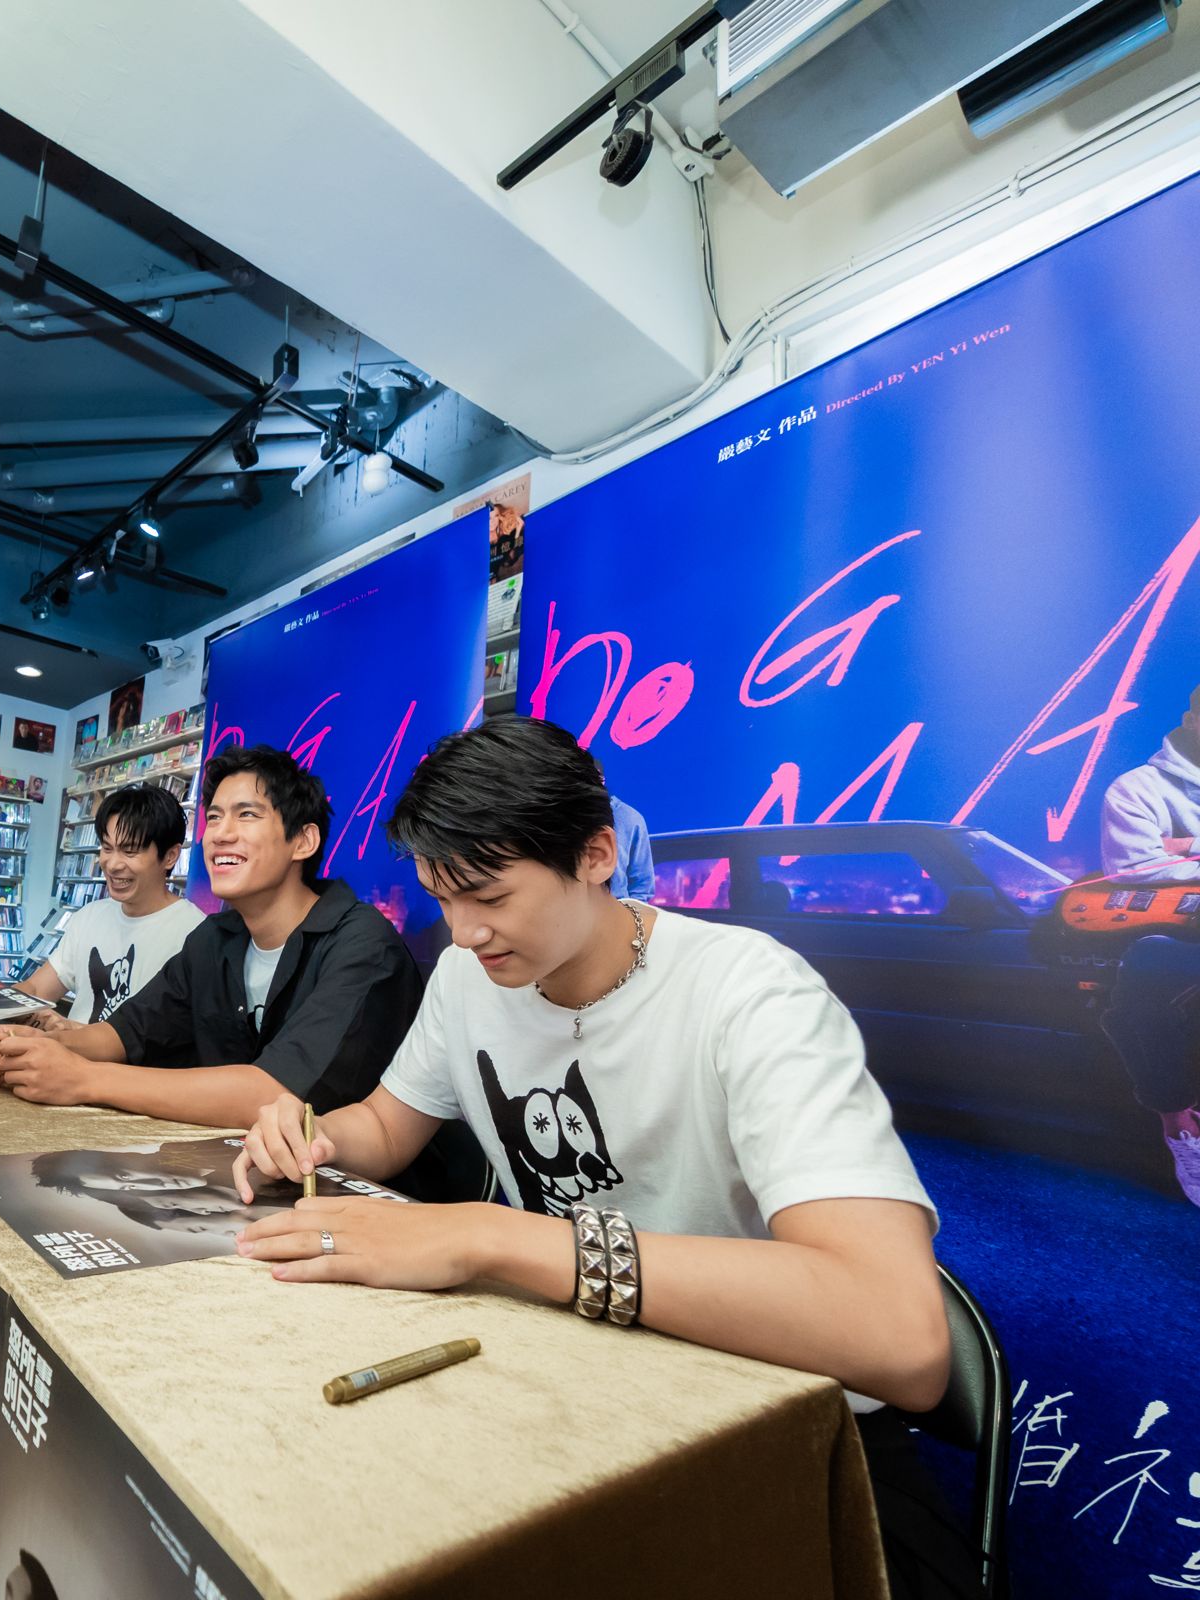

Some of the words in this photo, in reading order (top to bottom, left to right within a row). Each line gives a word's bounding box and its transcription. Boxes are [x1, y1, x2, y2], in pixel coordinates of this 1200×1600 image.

[825, 381, 884, 414] Directed
[887, 371, 906, 387] By
[910, 351, 944, 374] YEN
[949, 342, 968, 357] Yi
[972, 323, 1011, 346] Wen
[717, 427, 771, 464] 嚴藝文
[777, 405, 818, 435] 作品
